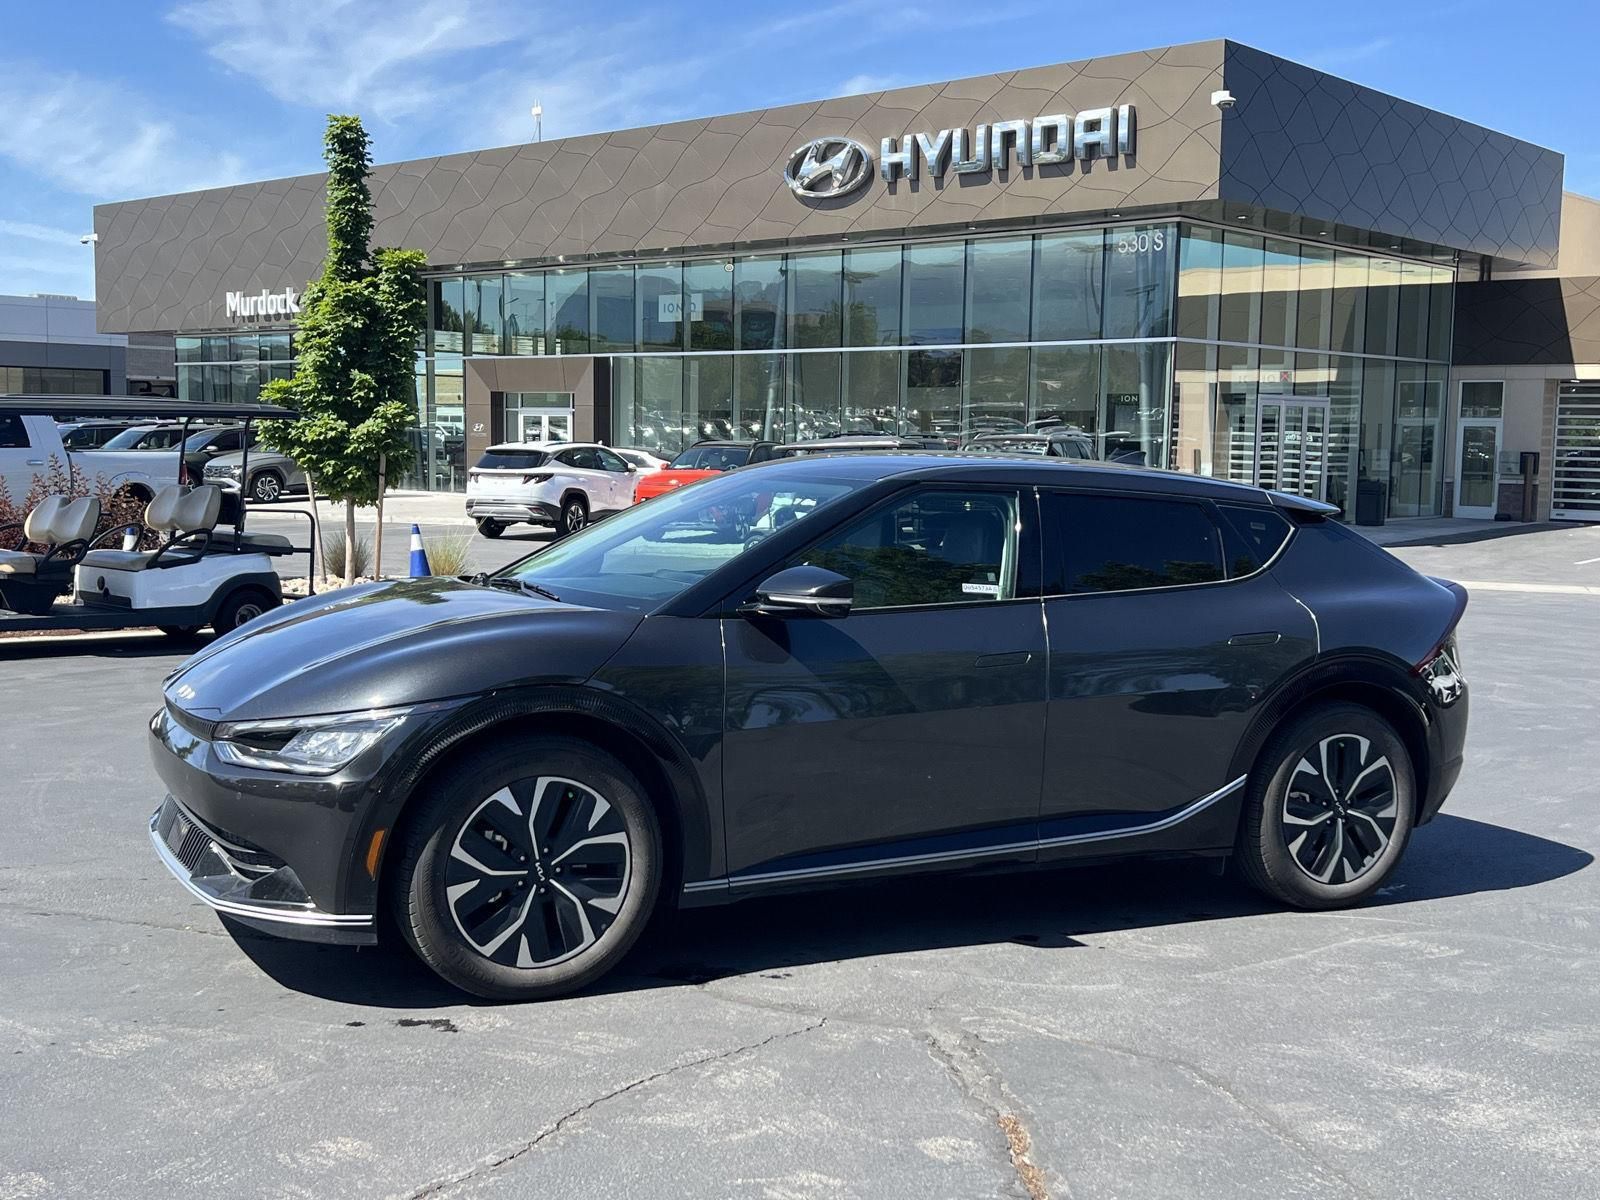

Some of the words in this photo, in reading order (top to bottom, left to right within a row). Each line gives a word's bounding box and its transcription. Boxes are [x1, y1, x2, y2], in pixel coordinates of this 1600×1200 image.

[880, 104, 1135, 183] HYUNDAI
[1118, 233, 1149, 253] 530
[1153, 232, 1164, 251] S
[225, 286, 301, 318] Murdock
[663, 302, 697, 313] IONQ
